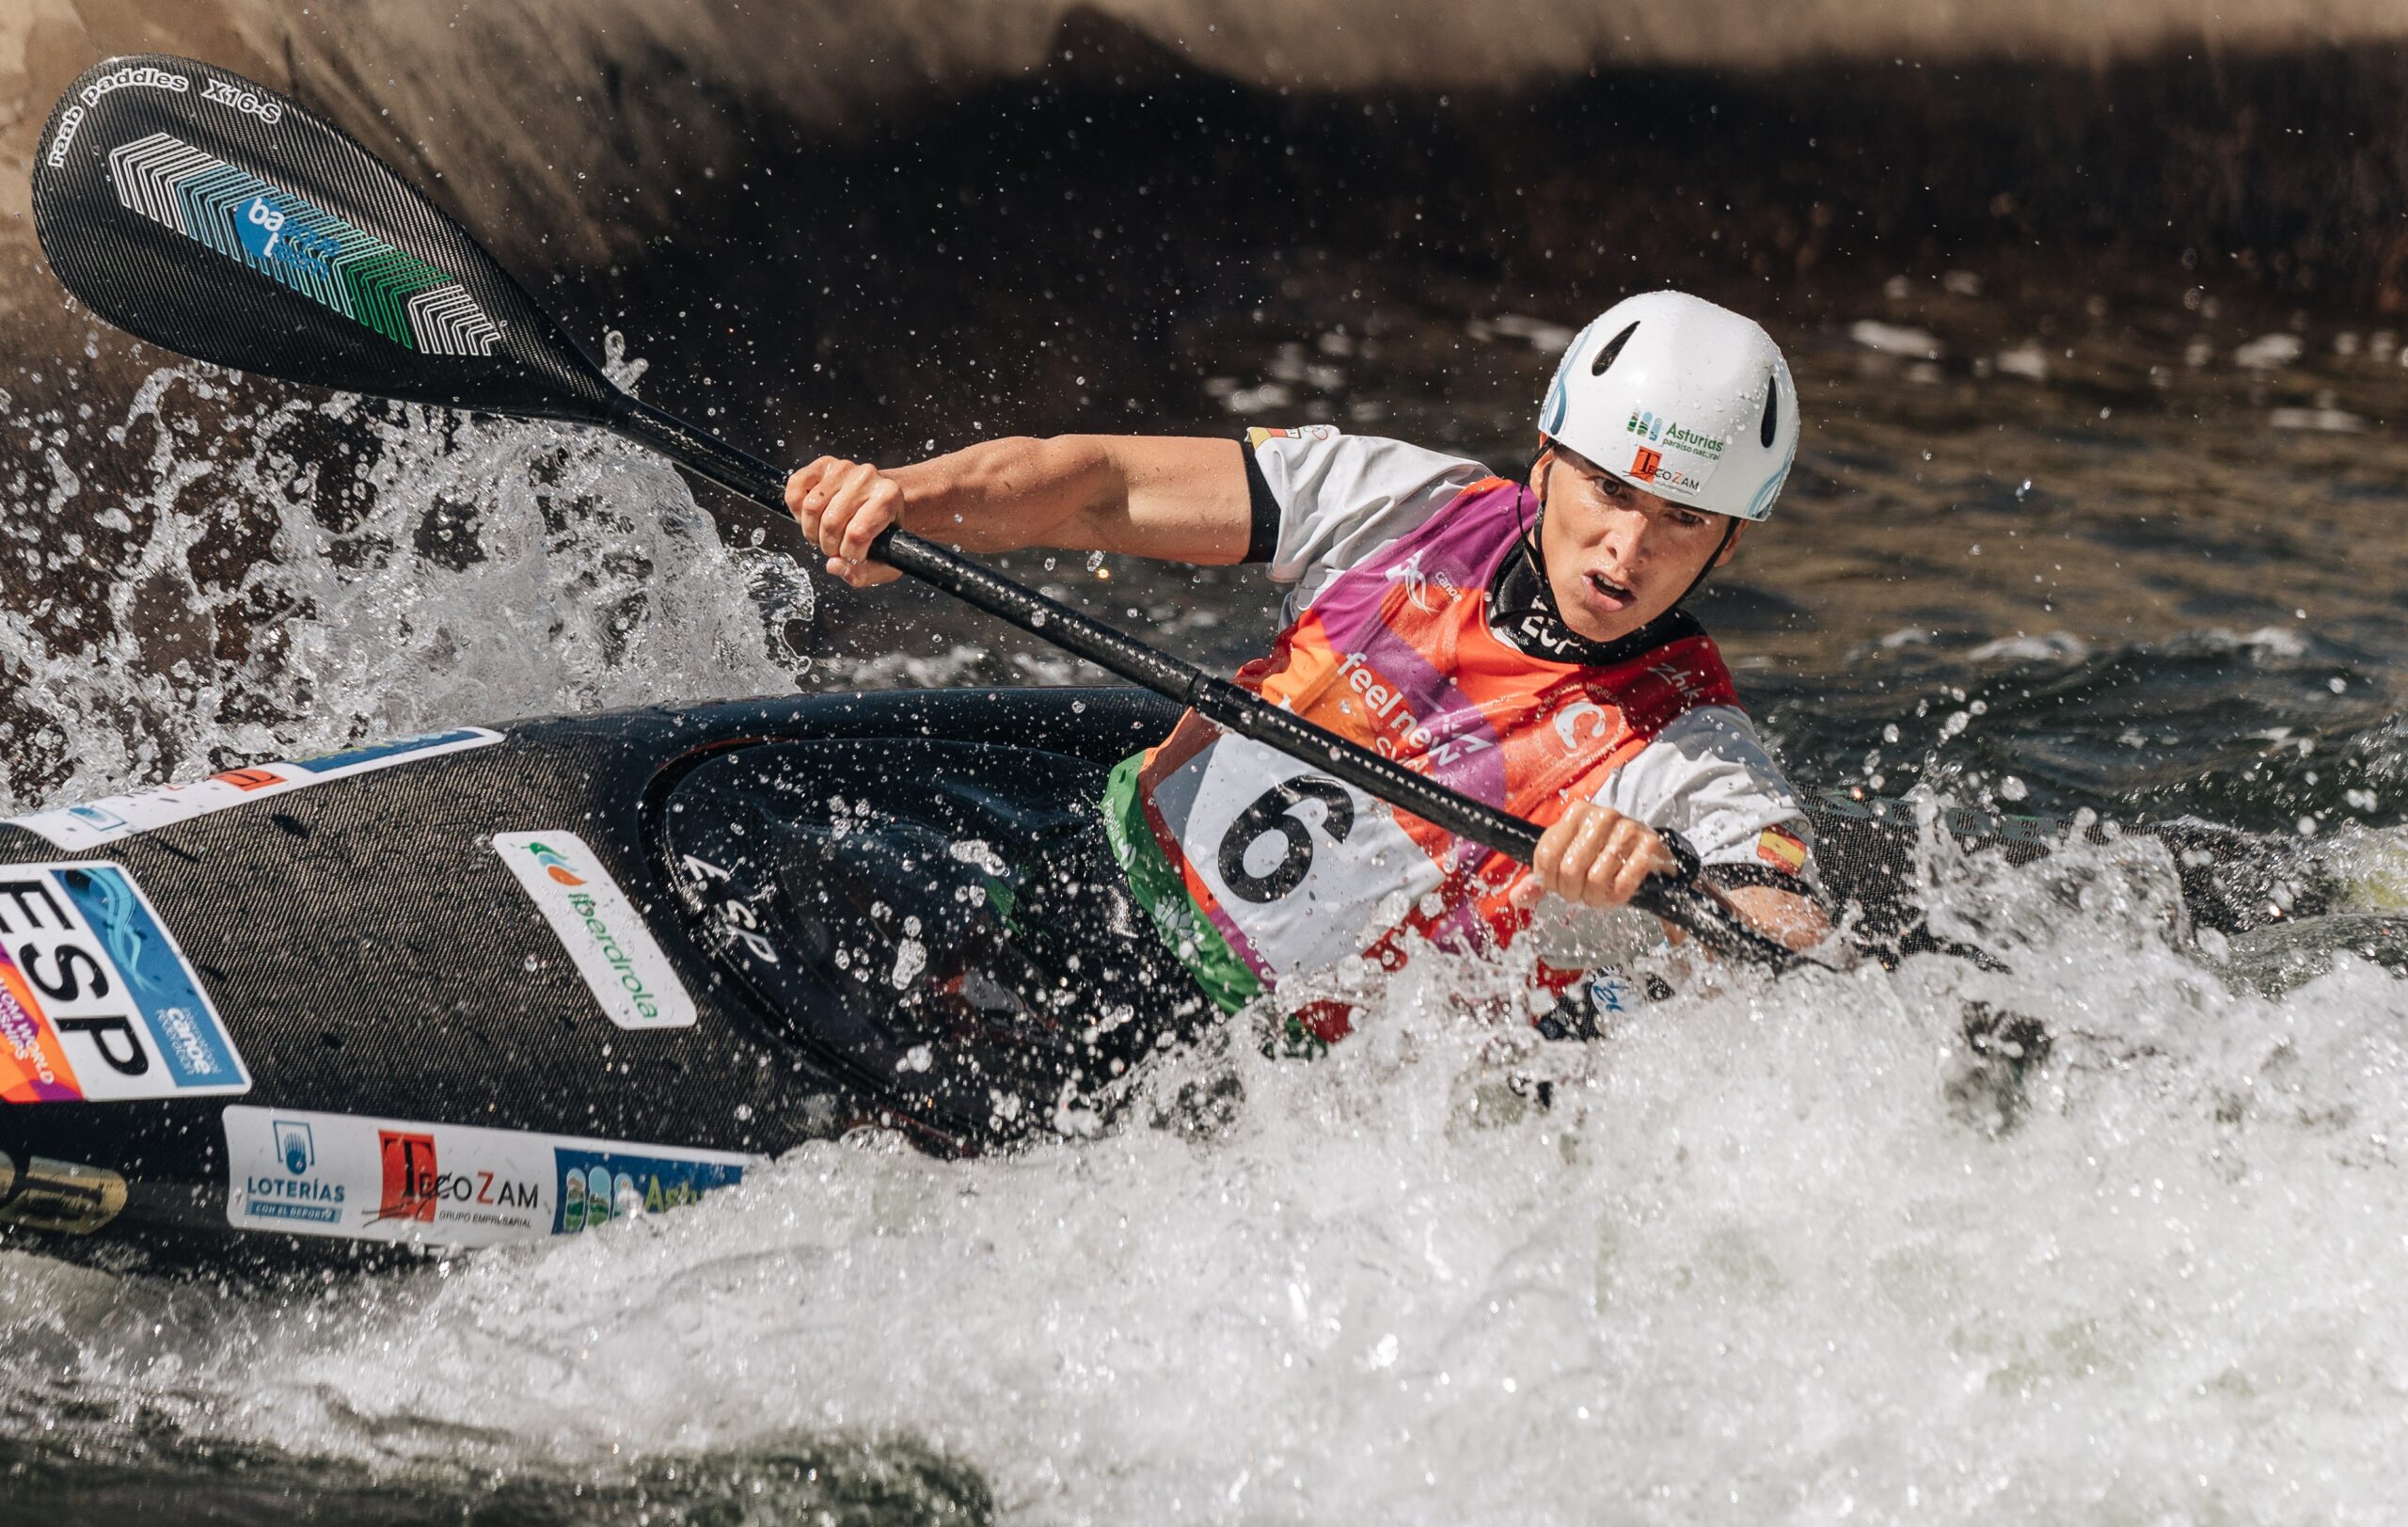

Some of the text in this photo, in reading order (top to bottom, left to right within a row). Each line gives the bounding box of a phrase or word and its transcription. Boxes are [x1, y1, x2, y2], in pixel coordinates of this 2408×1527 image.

[48, 67, 281, 167] raab paddles X16-S
[1666, 422, 1723, 453] Asturias
[1337, 652, 1402, 718] feel
[1390, 710, 1462, 767] new
[1218, 774, 1354, 904] 6
[0, 880, 149, 1075] ESP
[568, 893, 657, 1019] Iberdrola
[17, 1021, 55, 1085] WORLD
[167, 1008, 211, 1074] canoe
[247, 1175, 345, 1202] LOTERÍAS
[439, 1210, 532, 1228] GRUPO EMPRESARIAL
